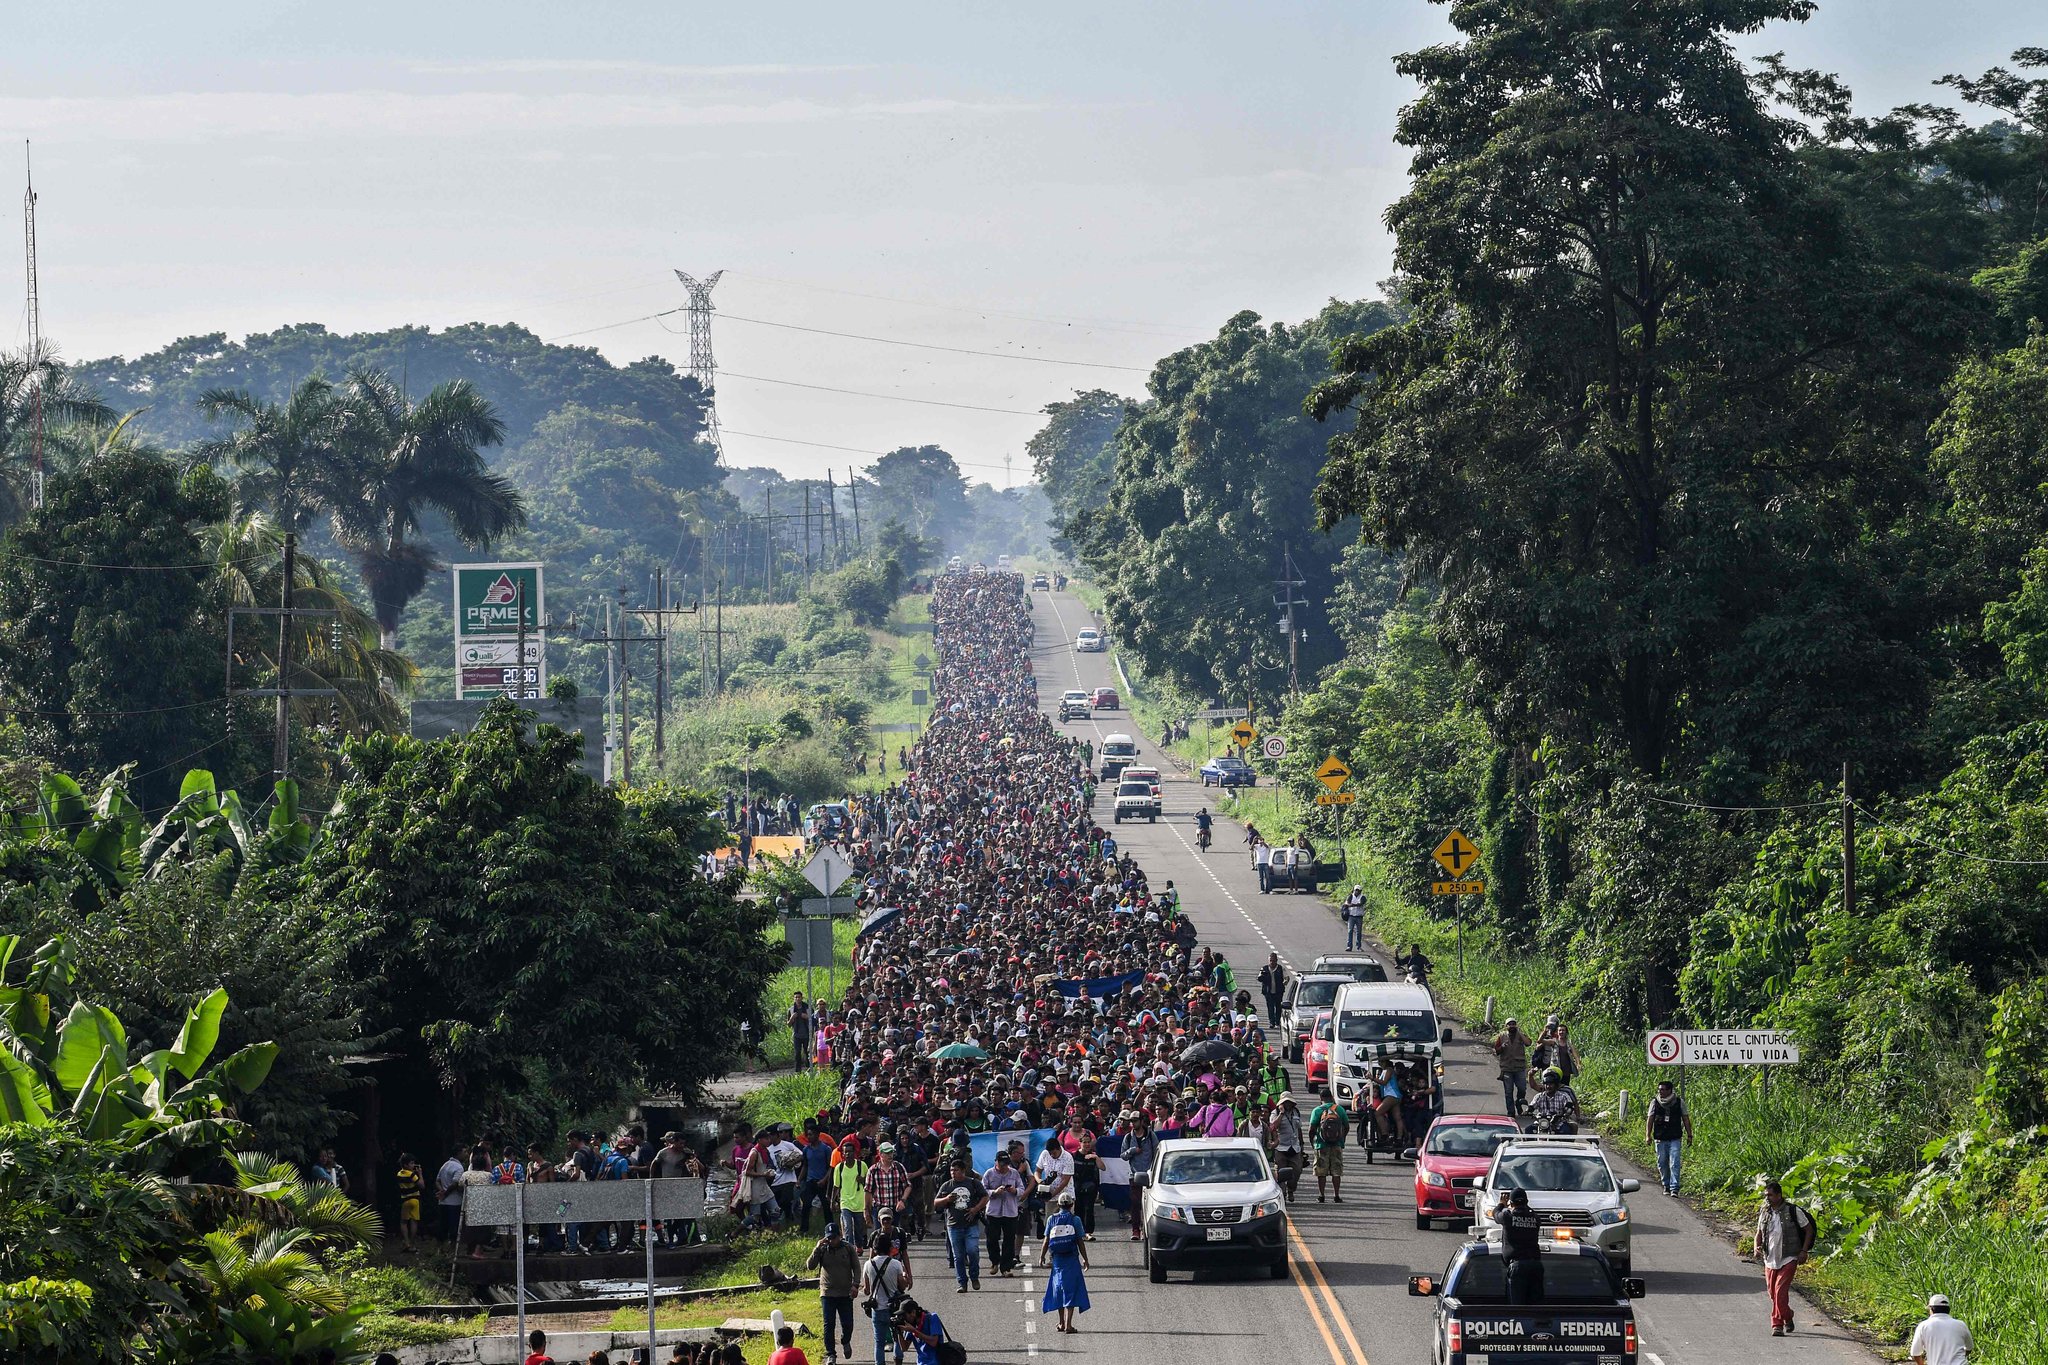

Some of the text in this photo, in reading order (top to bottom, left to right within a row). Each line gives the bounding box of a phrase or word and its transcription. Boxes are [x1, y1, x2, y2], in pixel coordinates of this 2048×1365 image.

[1270, 742, 1280, 750] 40
[1321, 796, 1327, 804] A
[1437, 884, 1444, 893] A
[1449, 884, 1467, 892] 250
[1686, 1034, 1724, 1046] UTILICE
[1728, 1034, 1741, 1045] EL
[1694, 1049, 1789, 1060] SALVA TU VIDA
[1465, 1319, 1621, 1337] POLICÍA FEDERAL
[1480, 1344, 1515, 1352] PROTEGER
[1523, 1344, 1547, 1352] SERVIR
[1554, 1344, 1564, 1352] LA
[1564, 1344, 1606, 1352] COMUNIDAD
